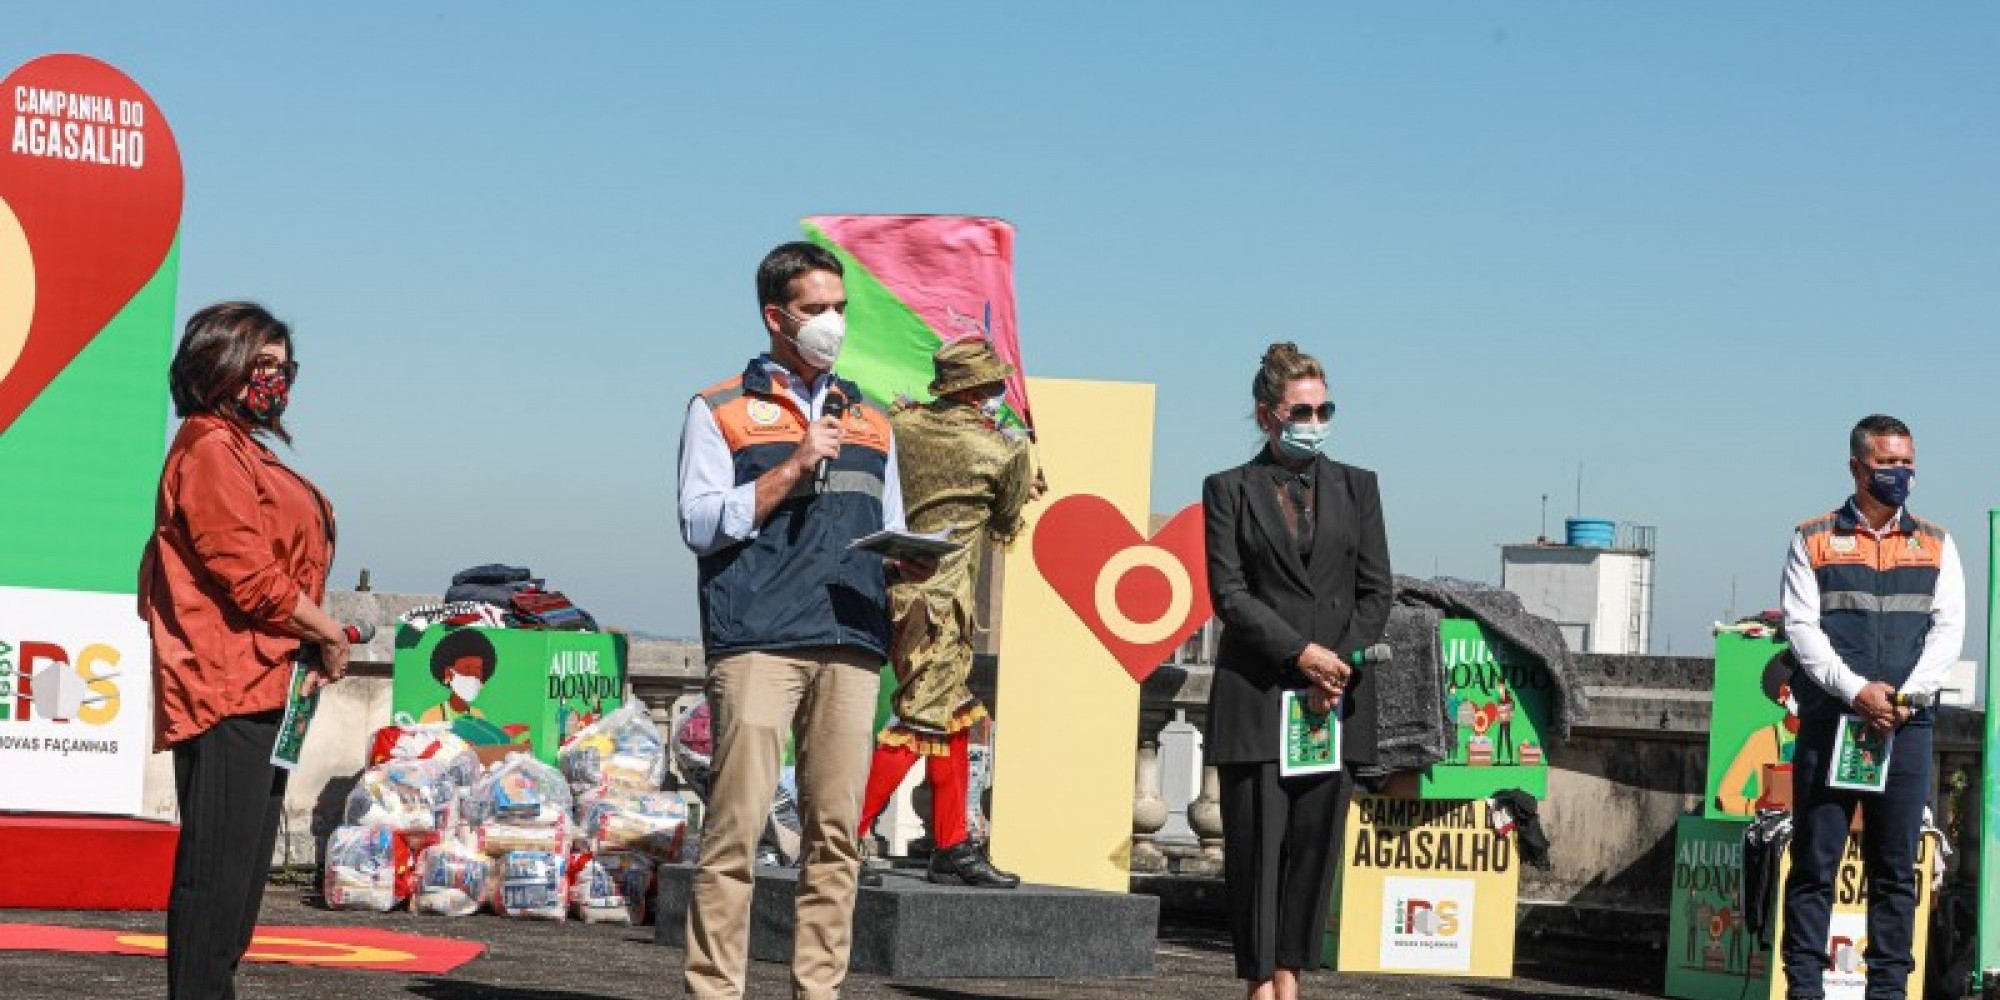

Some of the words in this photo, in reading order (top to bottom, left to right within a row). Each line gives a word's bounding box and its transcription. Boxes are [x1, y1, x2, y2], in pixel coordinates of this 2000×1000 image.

[15, 85, 115, 125] CAMPANHA
[119, 98, 144, 127] DO
[11, 115, 144, 169] AGASALHO
[15, 640, 121, 726] RS
[549, 650, 600, 681] AJUDE
[1359, 797, 1476, 829] CAMPANHA
[1352, 827, 1511, 873] AGASALHO
[1676, 839, 1744, 871] AJUDE
